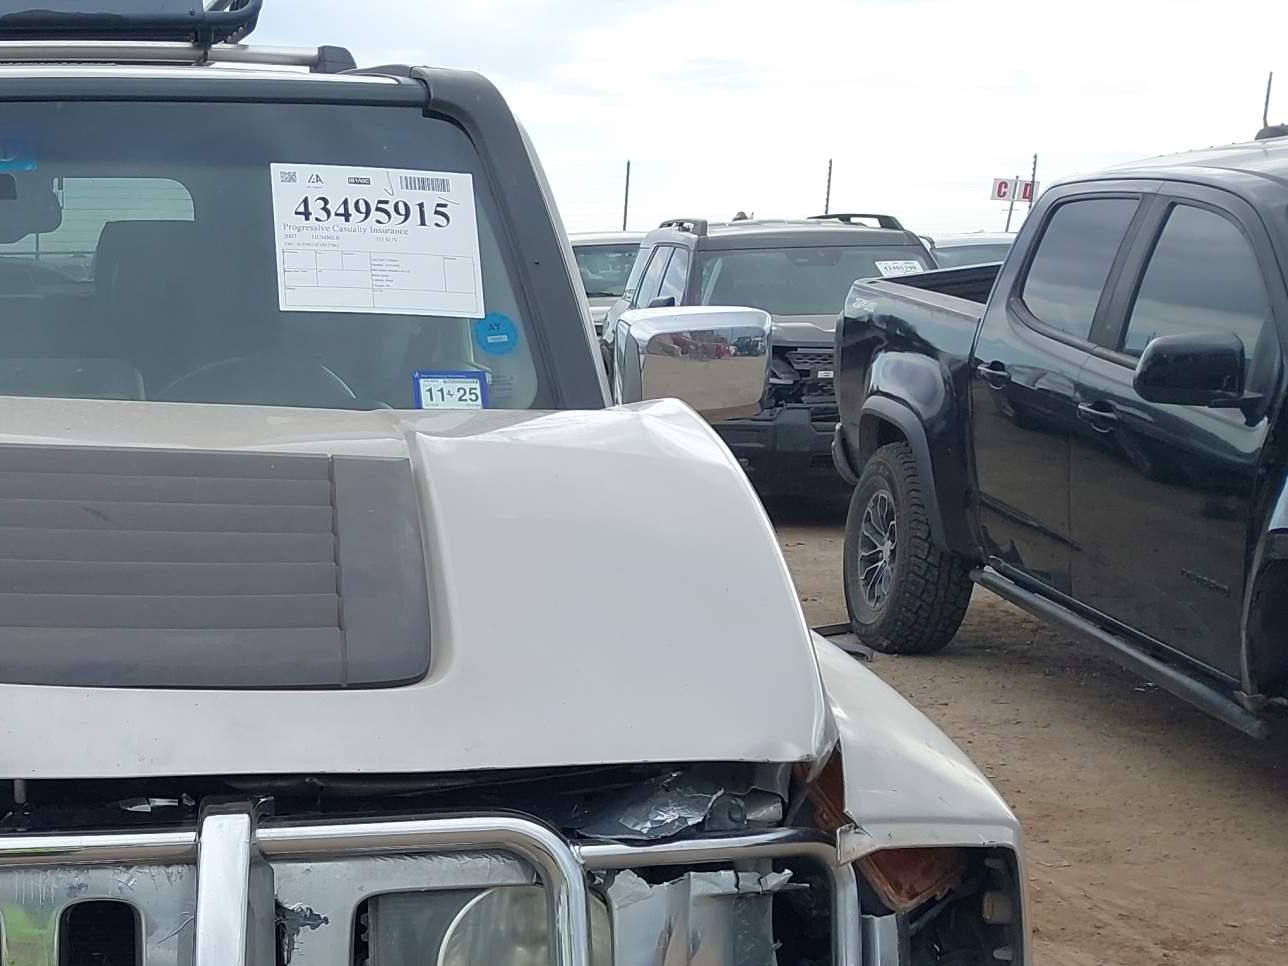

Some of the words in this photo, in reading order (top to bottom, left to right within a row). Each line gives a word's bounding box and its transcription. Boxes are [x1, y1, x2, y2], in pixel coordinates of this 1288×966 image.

[997, 181, 1008, 198] C
[1022, 183, 1033, 199] D
[294, 195, 451, 228] 43495915
[283, 223, 330, 233] Progressive
[332, 224, 367, 234] Casualty
[370, 225, 409, 235] Insurance
[457, 387, 479, 402] 25
